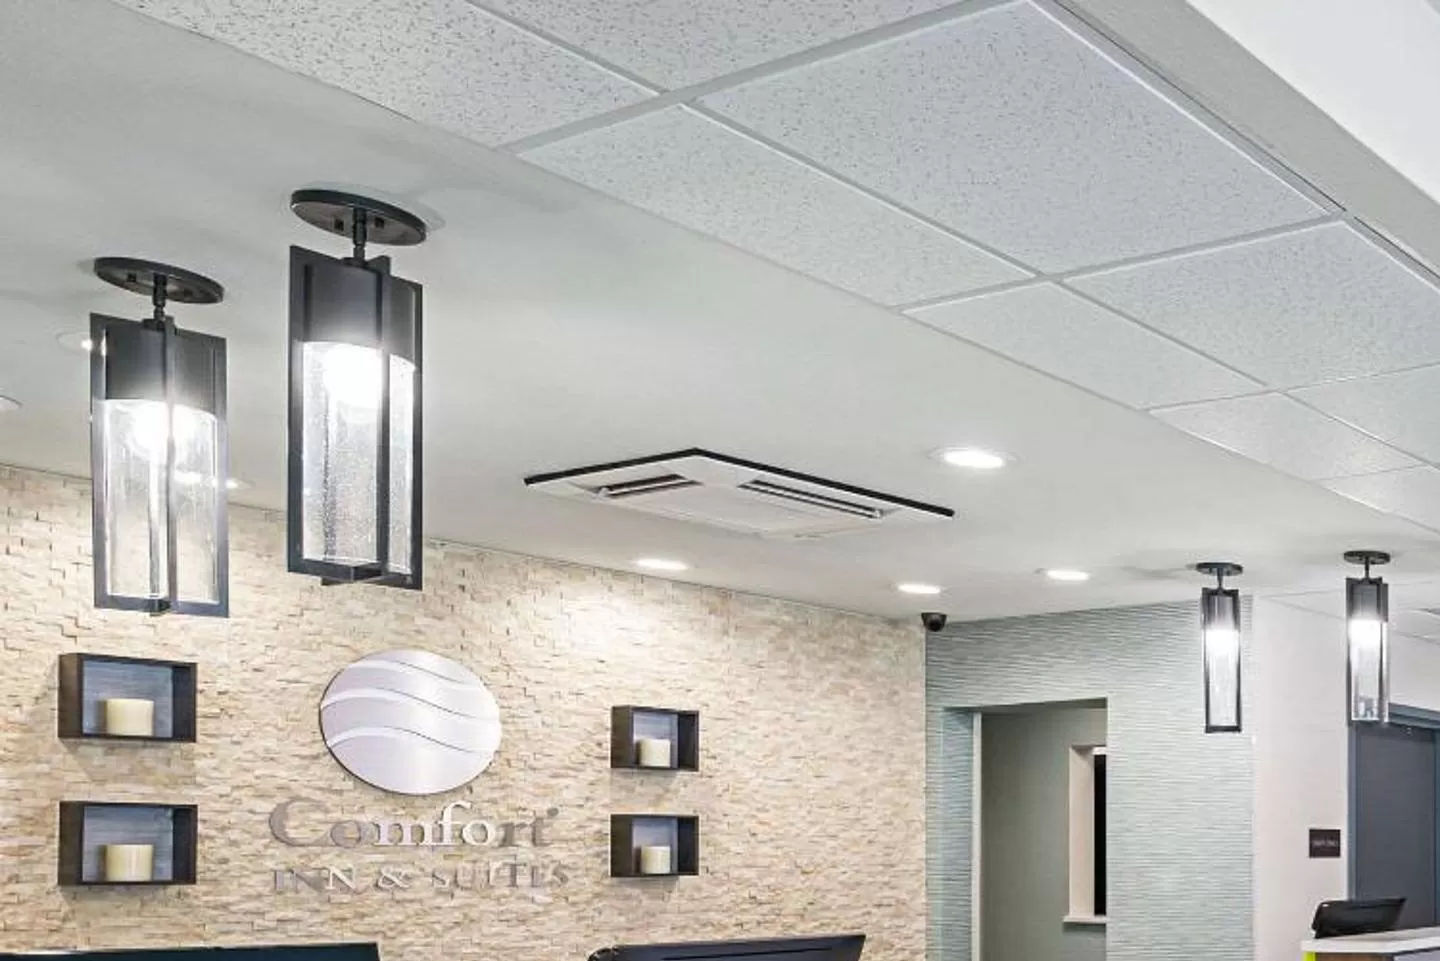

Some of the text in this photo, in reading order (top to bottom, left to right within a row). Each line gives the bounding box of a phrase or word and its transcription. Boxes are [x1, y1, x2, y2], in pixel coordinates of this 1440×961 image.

[268, 797, 554, 848] Comfort
[273, 860, 570, 893] INN & SUITES
